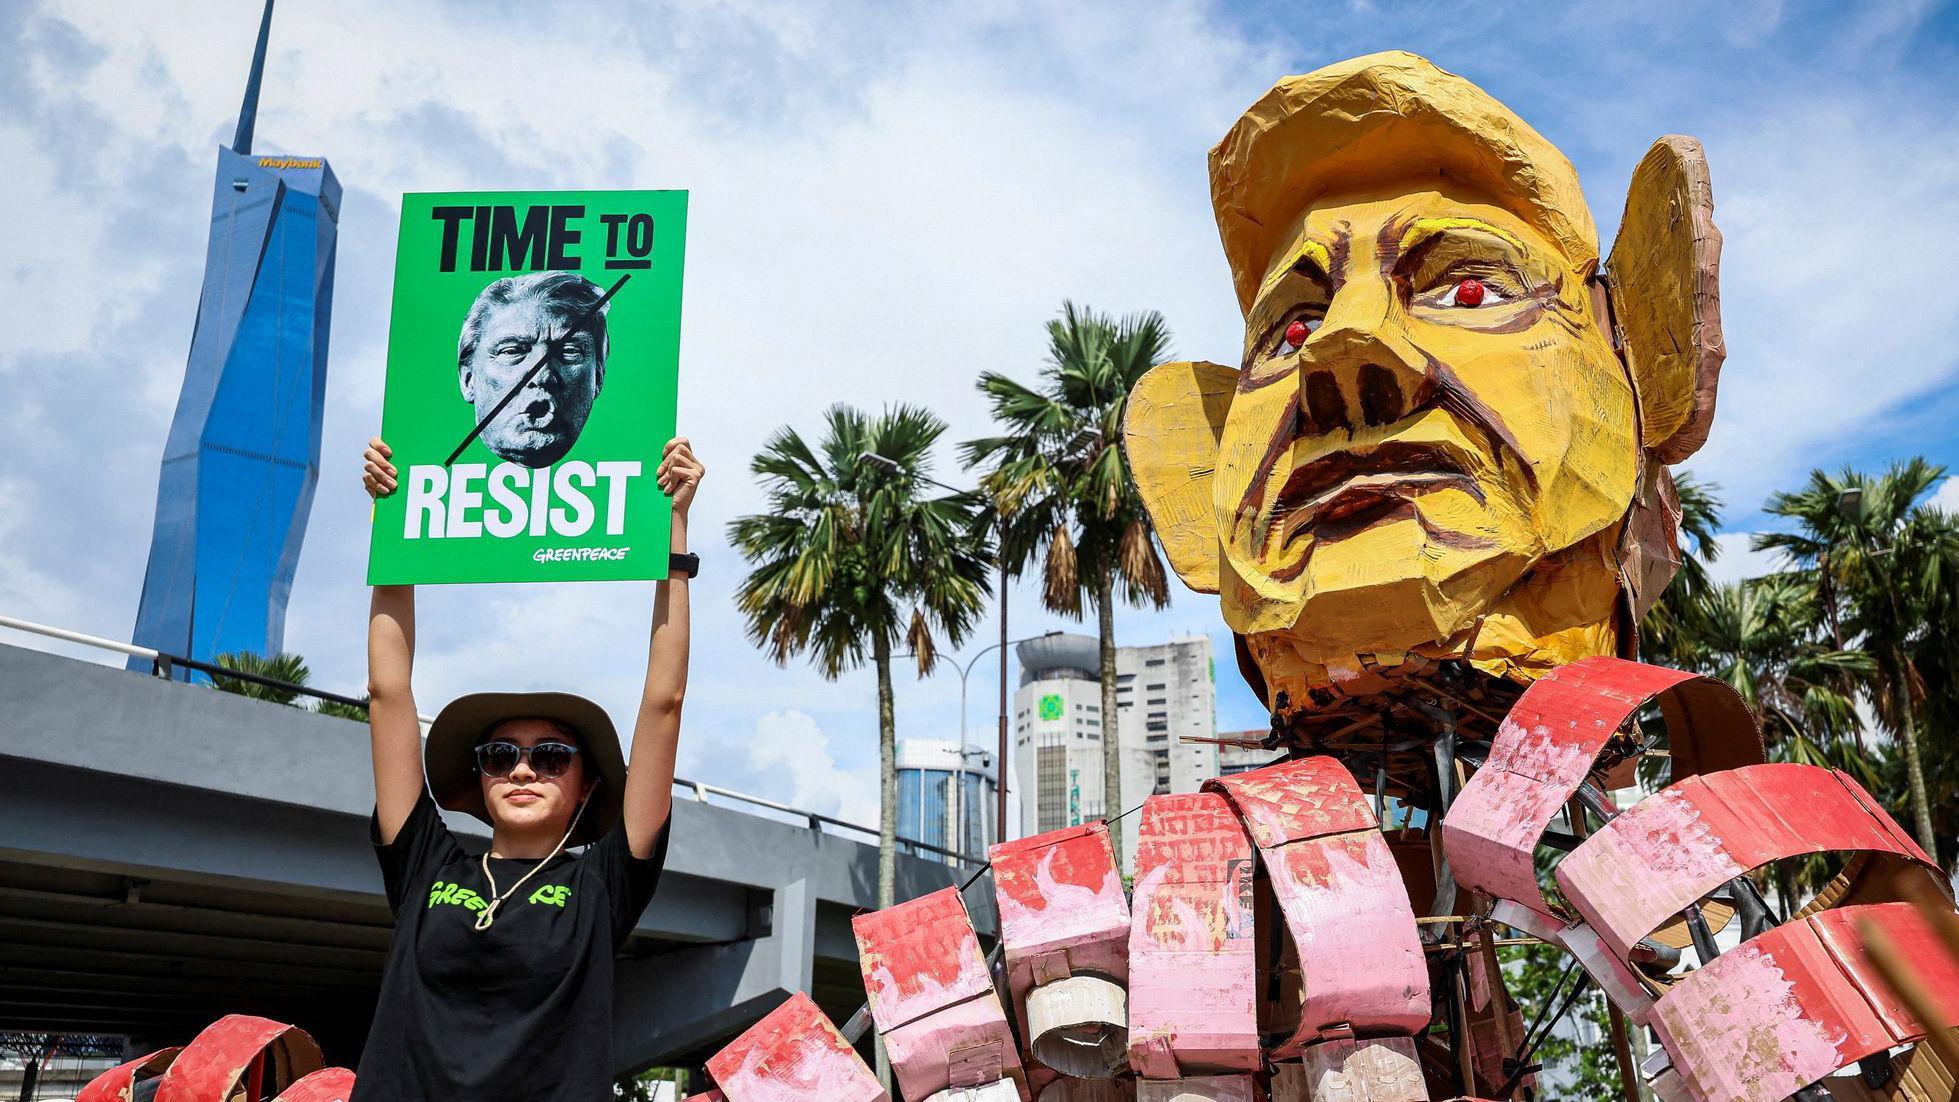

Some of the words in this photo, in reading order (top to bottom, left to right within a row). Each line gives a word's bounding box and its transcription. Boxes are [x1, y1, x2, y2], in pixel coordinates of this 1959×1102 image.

[259, 157, 322, 171] Maybank
[432, 205, 586, 272] TIME
[600, 213, 655, 258] TO
[404, 461, 641, 539] RESIST
[533, 547, 631, 564] GREENPEACE
